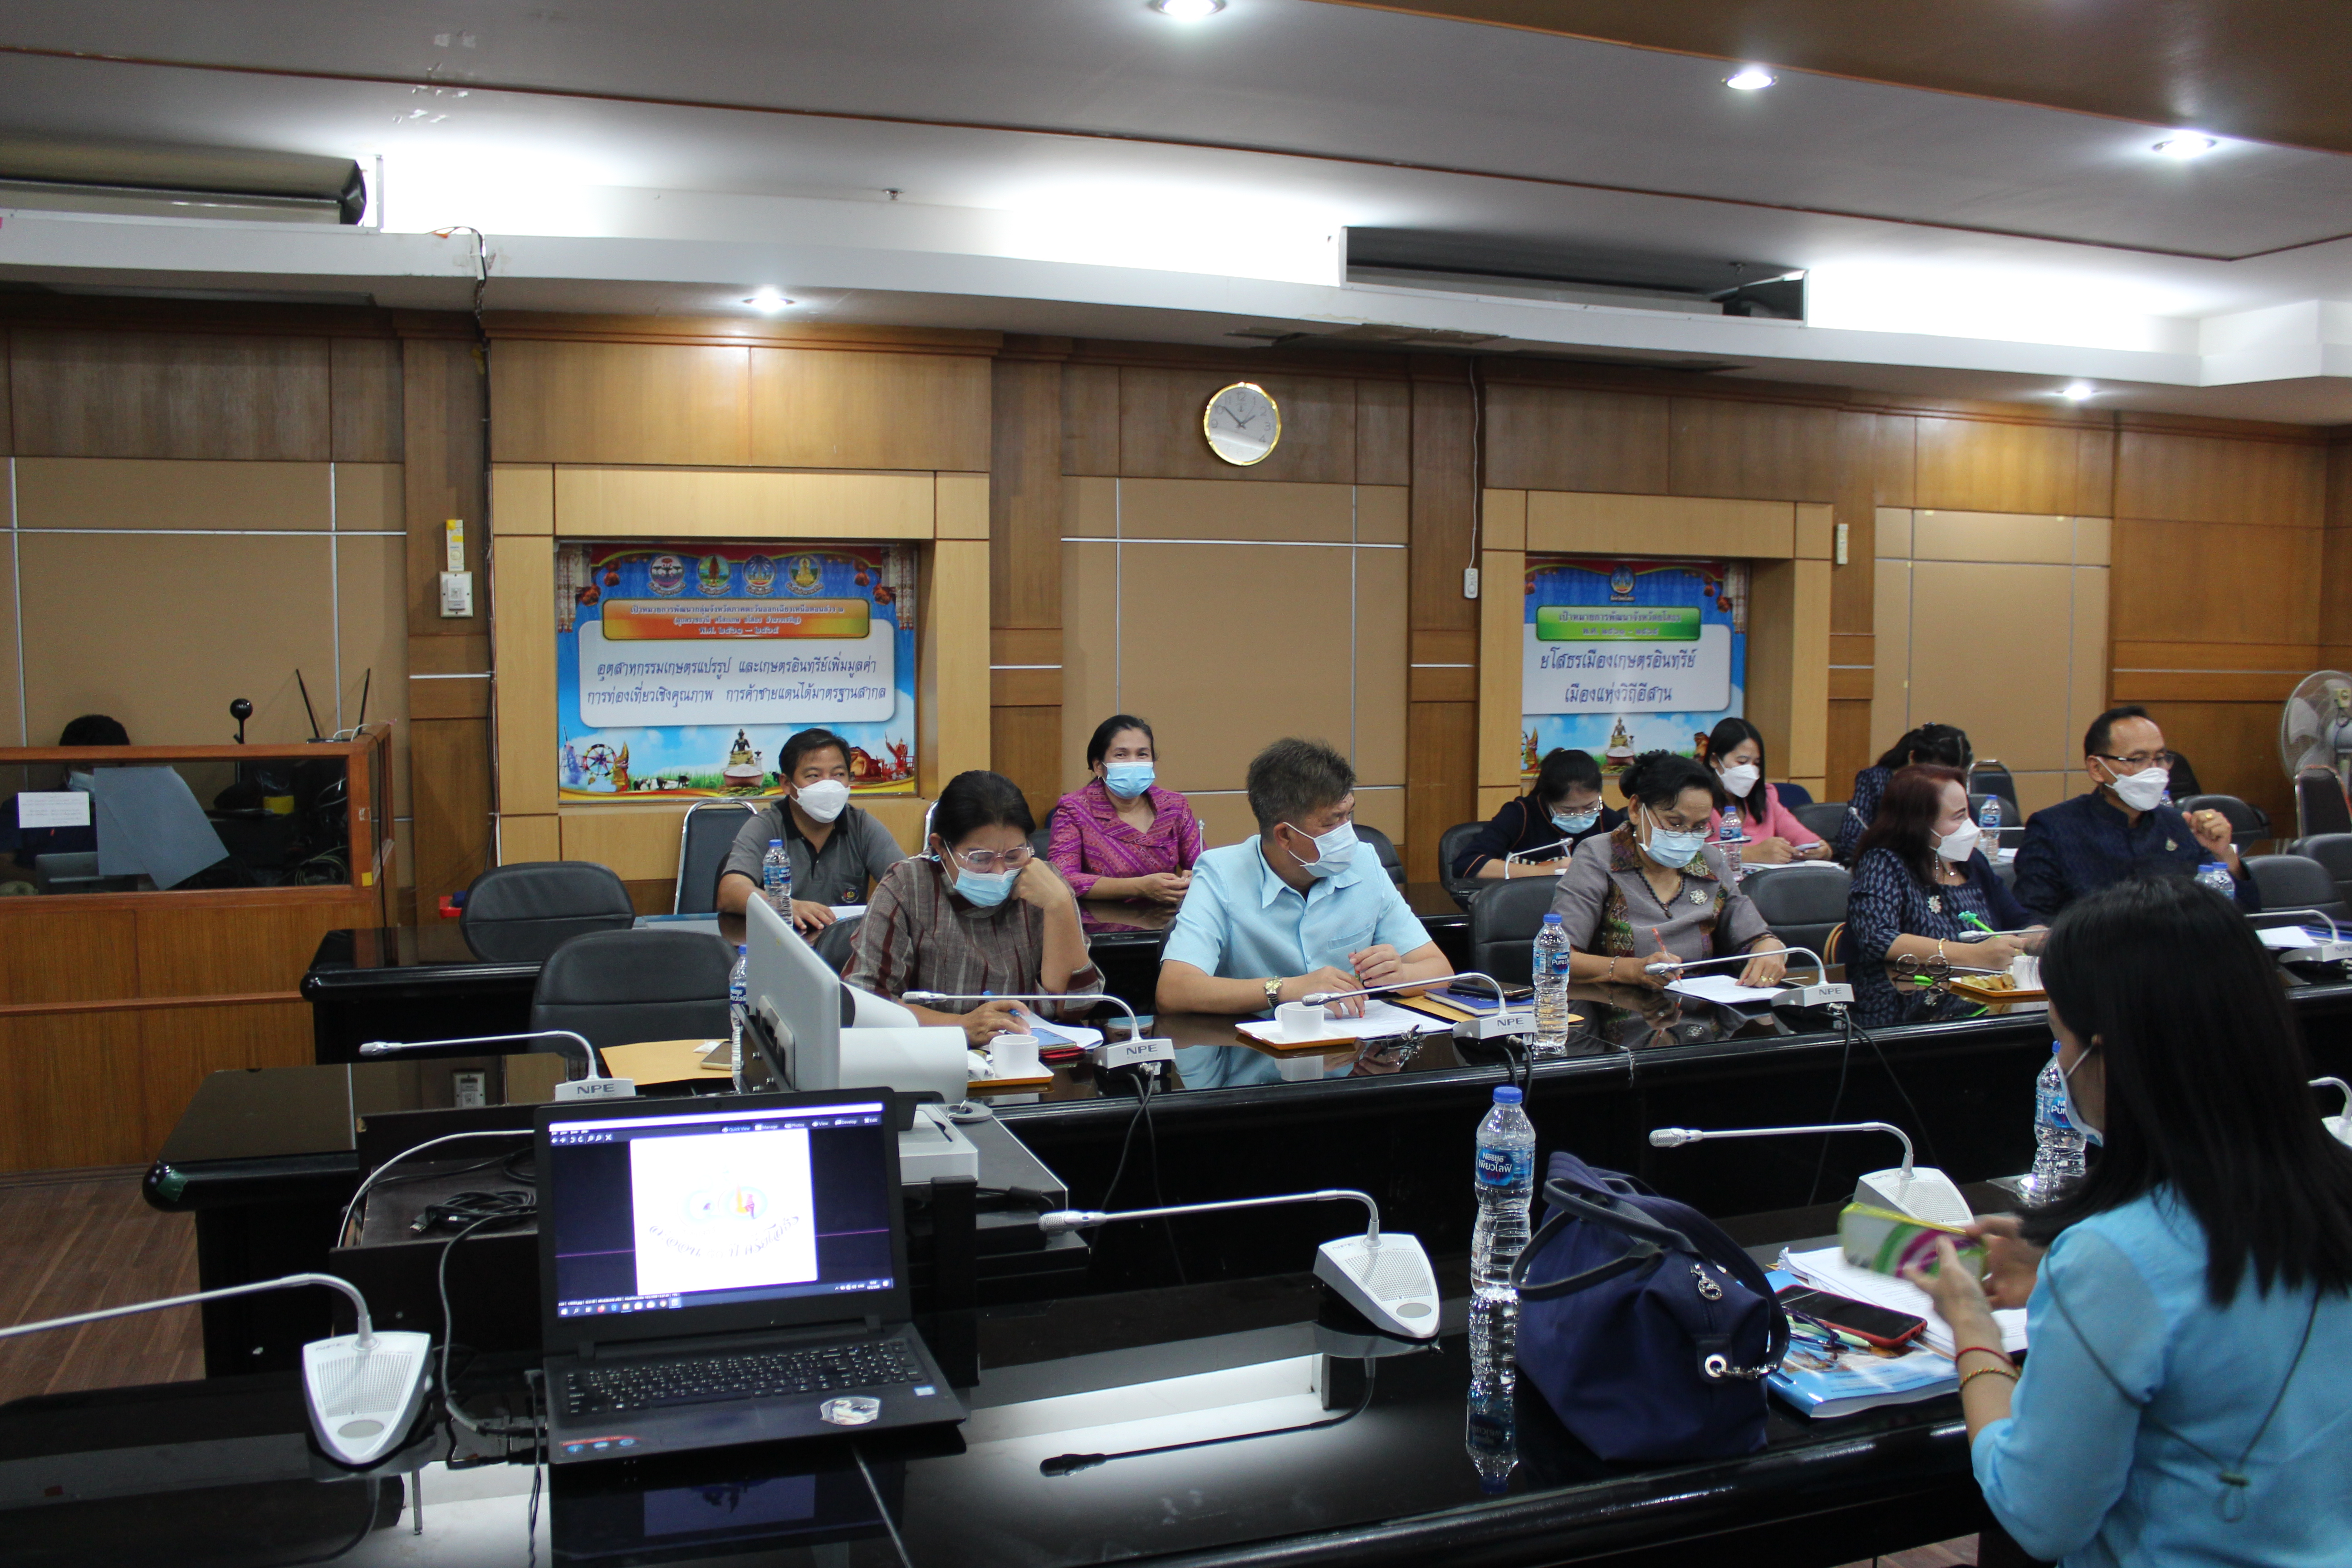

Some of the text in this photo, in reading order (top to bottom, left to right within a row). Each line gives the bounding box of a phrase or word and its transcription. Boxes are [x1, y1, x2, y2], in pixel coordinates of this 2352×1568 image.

[1540, 647, 1698, 669] ยโสธรเมืองเกษตรอินทรีย์
[598, 651, 876, 681] อุตสาหกรรมเกษตรแปรรูป และเกษตรอินทรีย์เพิ่มมูลค่า
[588, 681, 886, 708] การท่องเที่ยวเชิงคุณภาพ การค้าชายแดนได้มาตรฐานสากล
[1565, 682, 1673, 704] เมืองแห่งวิถีอีสาน
[1819, 987, 1842, 995] NPE
[1497, 1017, 1524, 1027] NPE
[1126, 1044, 1157, 1055] NPE
[577, 1083, 615, 1094] NPE
[2051, 1105, 2066, 1115] Pur
[1482, 1152, 1504, 1163] Nestlé
